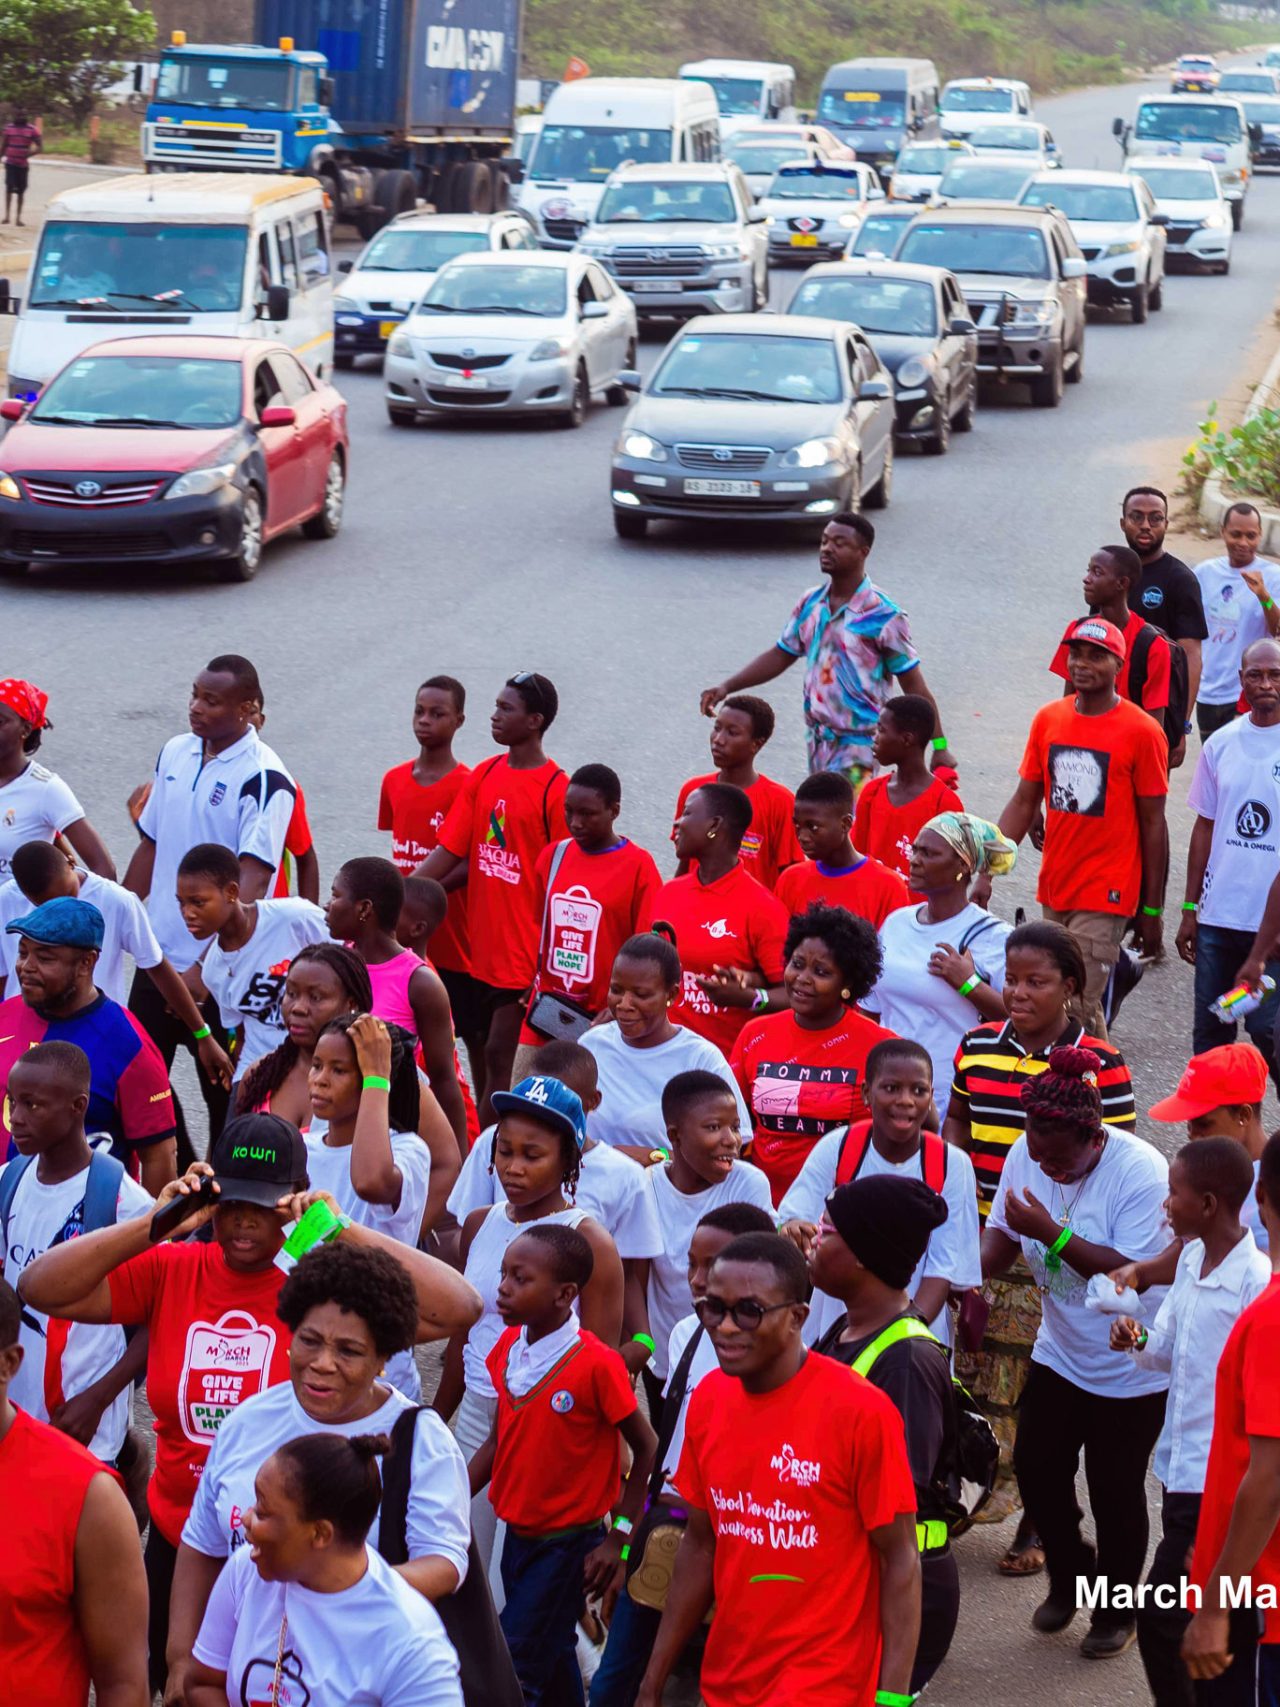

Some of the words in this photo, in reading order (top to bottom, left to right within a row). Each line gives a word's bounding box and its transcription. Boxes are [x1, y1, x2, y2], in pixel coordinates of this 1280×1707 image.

[1250, 842, 1276, 852] OMEGA
[560, 930, 584, 943] GIVE
[562, 940, 582, 952] LIFE
[556, 949, 585, 963] PLANT
[558, 960, 581, 971] HOPE
[822, 1033, 849, 1049] TOMMY
[763, 1063, 849, 1083] TOMMY
[525, 1077, 548, 1106] LA
[202, 1374, 244, 1391] GIVE
[205, 1389, 240, 1404] LIFE
[195, 1406, 234, 1418] PLA
[202, 1419, 221, 1430] HO
[769, 1521, 818, 1550] Walk
